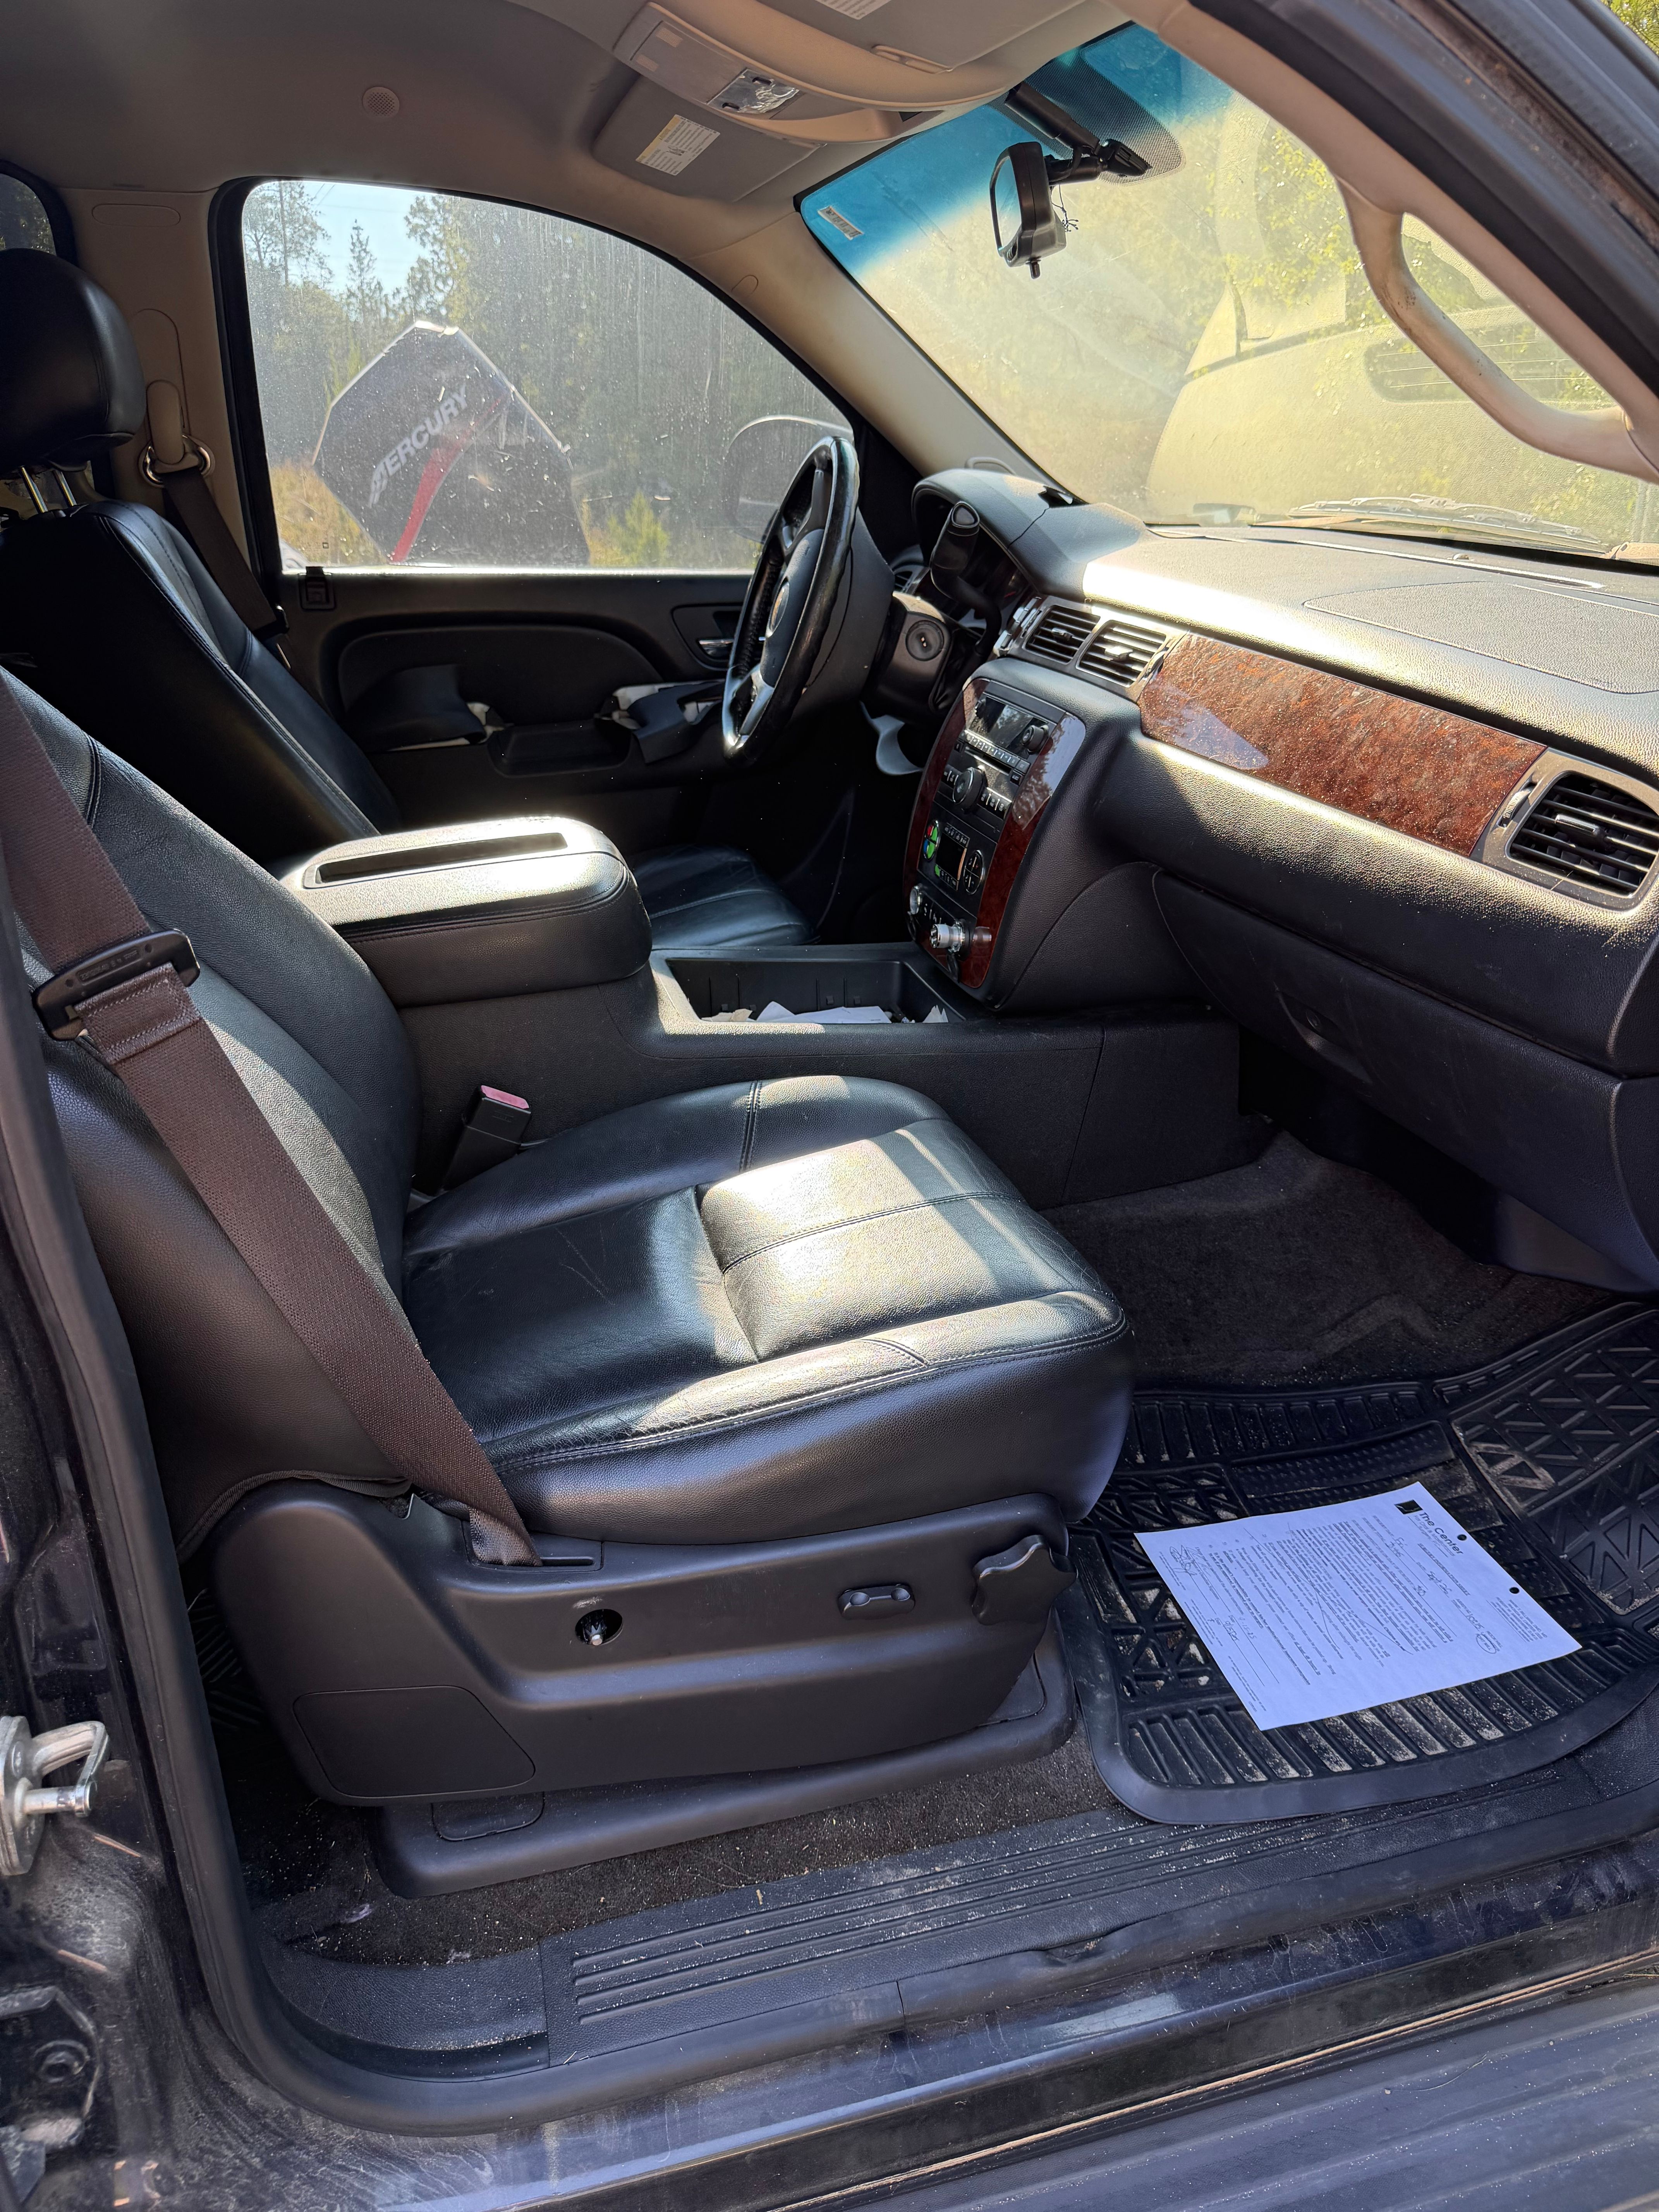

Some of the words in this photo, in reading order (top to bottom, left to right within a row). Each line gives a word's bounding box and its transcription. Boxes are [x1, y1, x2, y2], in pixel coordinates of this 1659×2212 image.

[369, 385, 467, 508] MERCURY
[1419, 1511, 1435, 1526] The
[1434, 1527, 1463, 1554] Center
